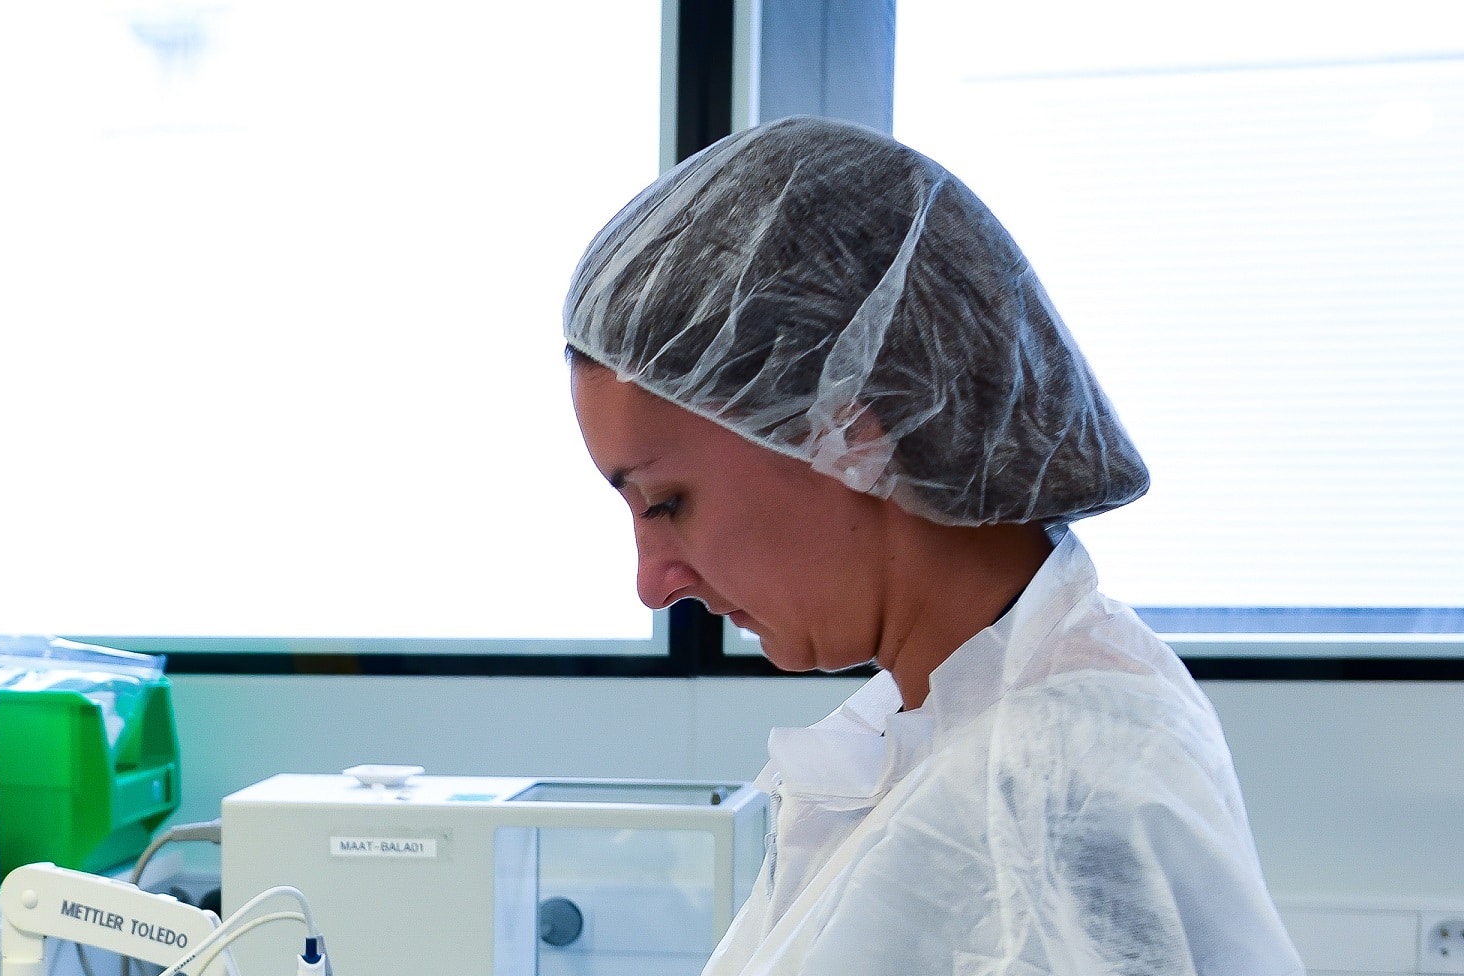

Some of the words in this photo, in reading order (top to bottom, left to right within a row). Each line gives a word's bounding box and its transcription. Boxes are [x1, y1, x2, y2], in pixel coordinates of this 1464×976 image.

[340, 840, 424, 853] MAAT-BALA01
[60, 899, 124, 931] METTLER
[131, 919, 188, 949] TOLEDO
